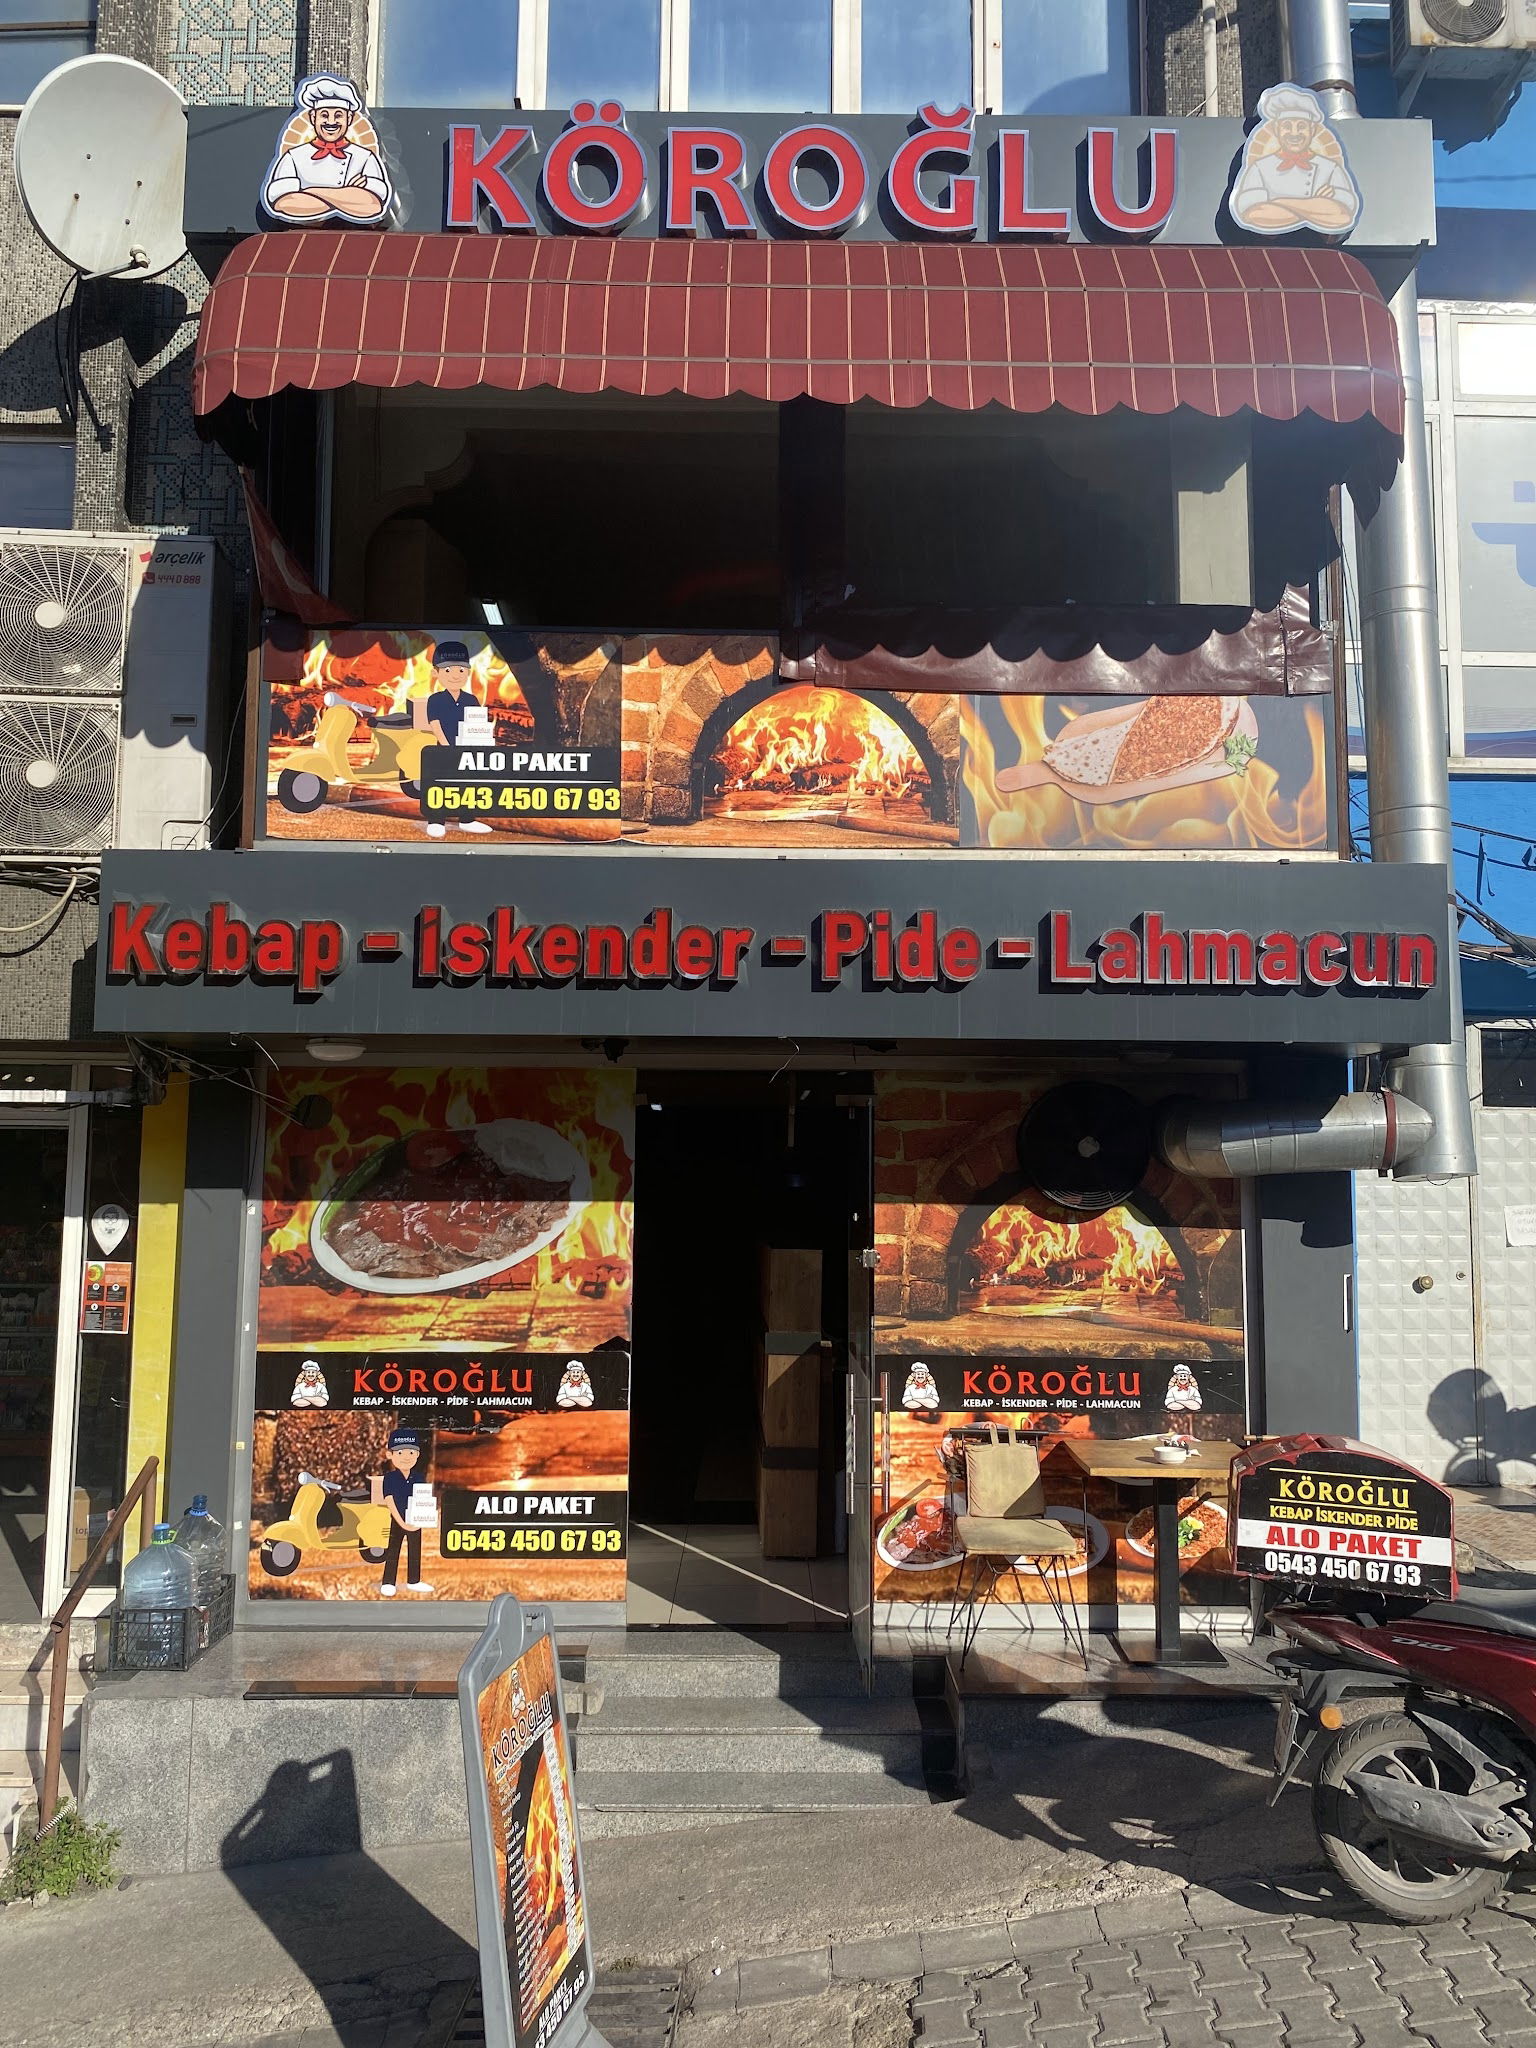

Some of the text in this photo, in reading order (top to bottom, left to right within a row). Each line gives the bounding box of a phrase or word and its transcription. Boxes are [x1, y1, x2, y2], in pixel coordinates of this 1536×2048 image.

[447, 99, 1179, 233] KÖROĞLU
[154, 552, 206, 566] arçelik
[458, 752, 592, 772] ALO PAKET
[427, 786, 620, 812] 0543 450 67 93
[109, 901, 347, 993] Kebap
[821, 908, 983, 983] Pide
[1050, 909, 1438, 989] Lahmacun
[354, 1362, 532, 1393] KÖROĞLU
[962, 1364, 1141, 1396] KÖROĞLU
[353, 1397, 384, 1406] KEBAP
[392, 1396, 438, 1406] İSKENDER
[446, 1396, 468, 1406] PİDE
[477, 1397, 532, 1406] LAHMACUN
[963, 1399, 994, 1408] KEBAP
[1002, 1397, 1048, 1408] İSKENDER
[1056, 1398, 1078, 1408] PİDE
[1086, 1400, 1141, 1408] LAHMACUN
[474, 1496, 595, 1515] ALO PAKET
[1279, 1476, 1409, 1508] KÖROĞLU
[1270, 1505, 1418, 1530] KEBAP İSKENDER PİDE
[446, 1530, 622, 1552] 0543 450 67 93
[1266, 1526, 1422, 1559] ALO PAKET
[1264, 1551, 1422, 1586] 0543 450 67 93
[492, 1691, 552, 1769] KÖROĞLU
[546, 1970, 584, 2038] 450 67 93
